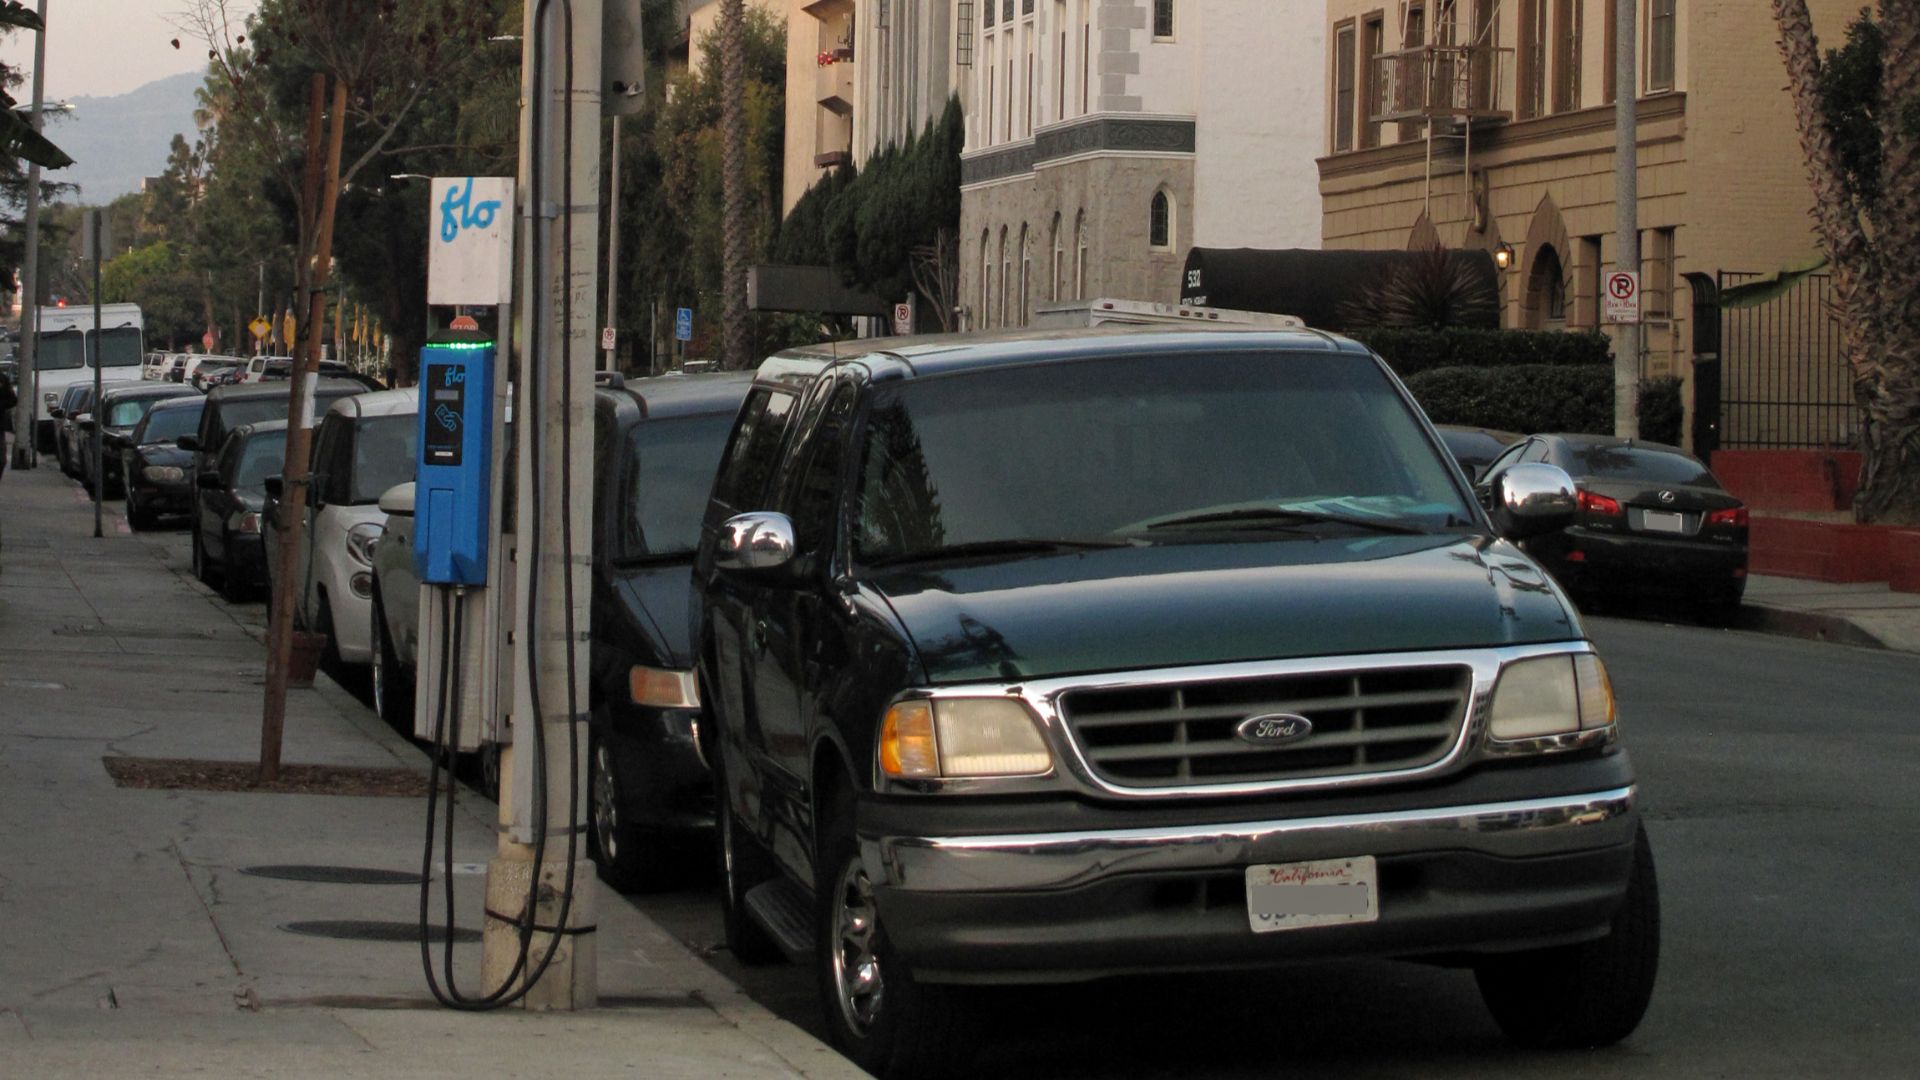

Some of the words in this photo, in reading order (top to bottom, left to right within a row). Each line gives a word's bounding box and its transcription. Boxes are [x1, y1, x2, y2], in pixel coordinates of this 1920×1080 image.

[440, 176, 502, 243] flo
[1187, 269, 1201, 288] 532
[444, 366, 466, 386] flo
[1256, 719, 1296, 737] Ford
[1273, 867, 1351, 885] California
